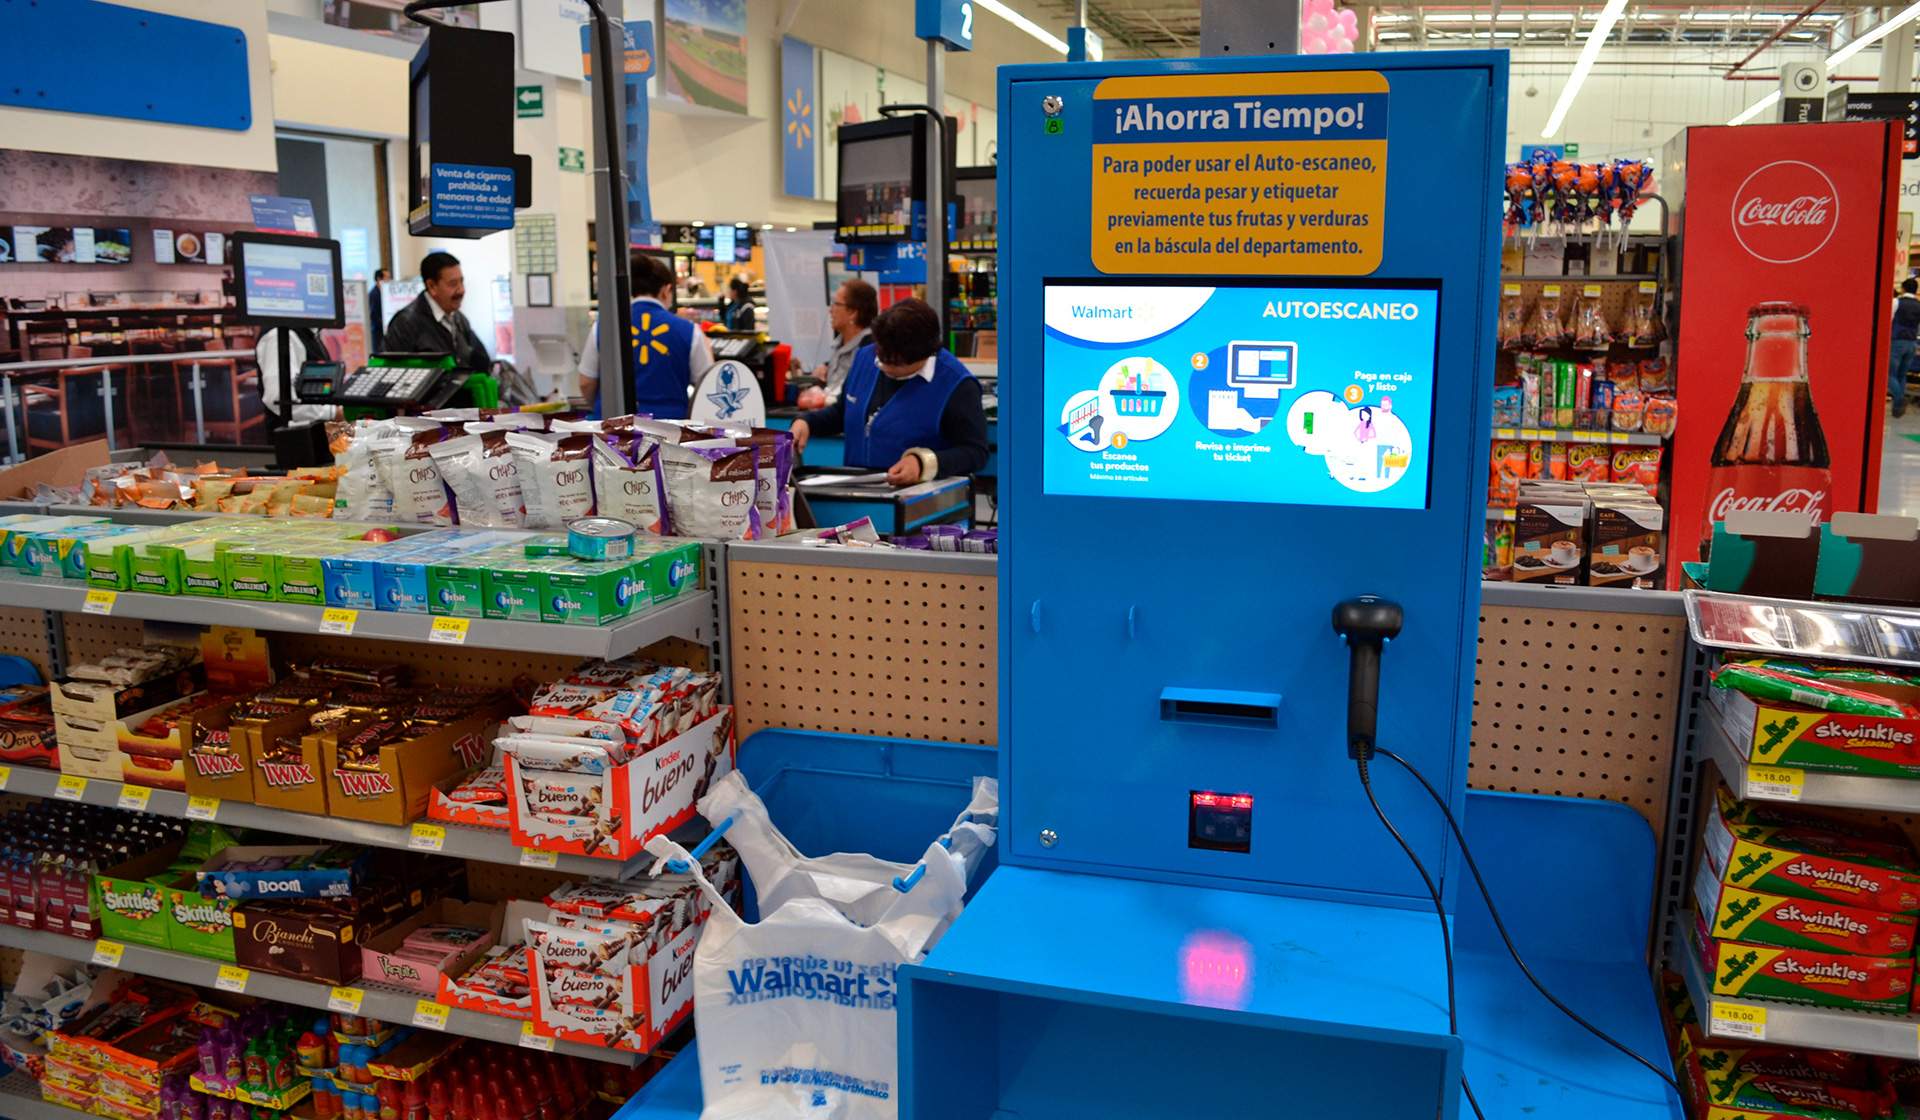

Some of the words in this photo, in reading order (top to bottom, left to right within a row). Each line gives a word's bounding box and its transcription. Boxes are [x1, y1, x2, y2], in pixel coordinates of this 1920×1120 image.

[962, 3, 972, 39] 2
[1115, 103, 1230, 134] ¡Ahorra
[1233, 101, 1364, 135] Tiempo!
[1103, 156, 1139, 173] Para
[1143, 155, 1191, 177] poder
[1195, 156, 1231, 172] usar
[1235, 154, 1250, 172] el
[1254, 154, 1377, 173] Auto-escaneo,
[436, 168, 462, 178] Venta
[464, 170, 475, 179] de
[476, 171, 512, 182] cigarros
[448, 182, 491, 192] prohibida
[1134, 184, 1201, 200] recuerda
[1205, 185, 1247, 203] pesar
[1251, 186, 1259, 203] y
[1263, 183, 1339, 202] etiquetar
[436, 192, 475, 202] menores
[476, 194, 488, 203] de
[489, 195, 512, 205] edad
[1108, 211, 1204, 230] previamente
[1209, 213, 1232, 226] tus
[1236, 210, 1283, 226] frutas
[1287, 213, 1296, 230] y
[1300, 210, 1369, 226] verduras
[1738, 196, 1832, 227] Coca-Cola
[1115, 240, 1133, 253] en
[1137, 237, 1150, 253] la
[1155, 237, 1211, 253] báscula
[1215, 237, 1239, 253] del
[1243, 237, 1363, 257] departamento.
[1072, 304, 1133, 320] Walmart
[1262, 301, 1419, 321] AUTOESCANEO
[1196, 355, 1204, 367] 2
[1354, 371, 1377, 382] Paga
[1379, 373, 1391, 381] en
[1393, 372, 1412, 383] caja
[1350, 388, 1358, 399] 3
[1368, 383, 1374, 392] y
[1376, 381, 1397, 391] listo
[1102, 451, 1137, 461] Escanea
[1195, 441, 1224, 452] Revisa
[1225, 443, 1231, 451] e
[1232, 442, 1271, 454] imprime
[1213, 452, 1223, 461] tu
[1225, 453, 1251, 462] ticket
[1613, 449, 1660, 471] Cheetos
[1090, 461, 1104, 469] tus
[1105, 462, 1149, 472] productos
[671, 561, 695, 584] Orbit
[233, 579, 267, 592] DOUBLEMINT
[283, 583, 318, 596] DOUBLEMINT
[616, 579, 645, 604] Orbit
[440, 590, 466, 603] Orbit
[498, 593, 524, 606] Orbit
[555, 598, 581, 611] Orbit
[189, 750, 244, 776] TWIX
[655, 750, 680, 771] Kinder
[257, 759, 314, 786] TWIX
[335, 768, 393, 796] TWIX
[643, 753, 694, 814] bueno
[539, 789, 578, 803] bueno
[105, 892, 159, 912] Skittles
[176, 904, 232, 926] Skittles
[253, 919, 314, 944] Bianchi
[546, 942, 587, 957] bueno
[561, 977, 603, 991] bueno
[728, 963, 869, 999] Walmart
